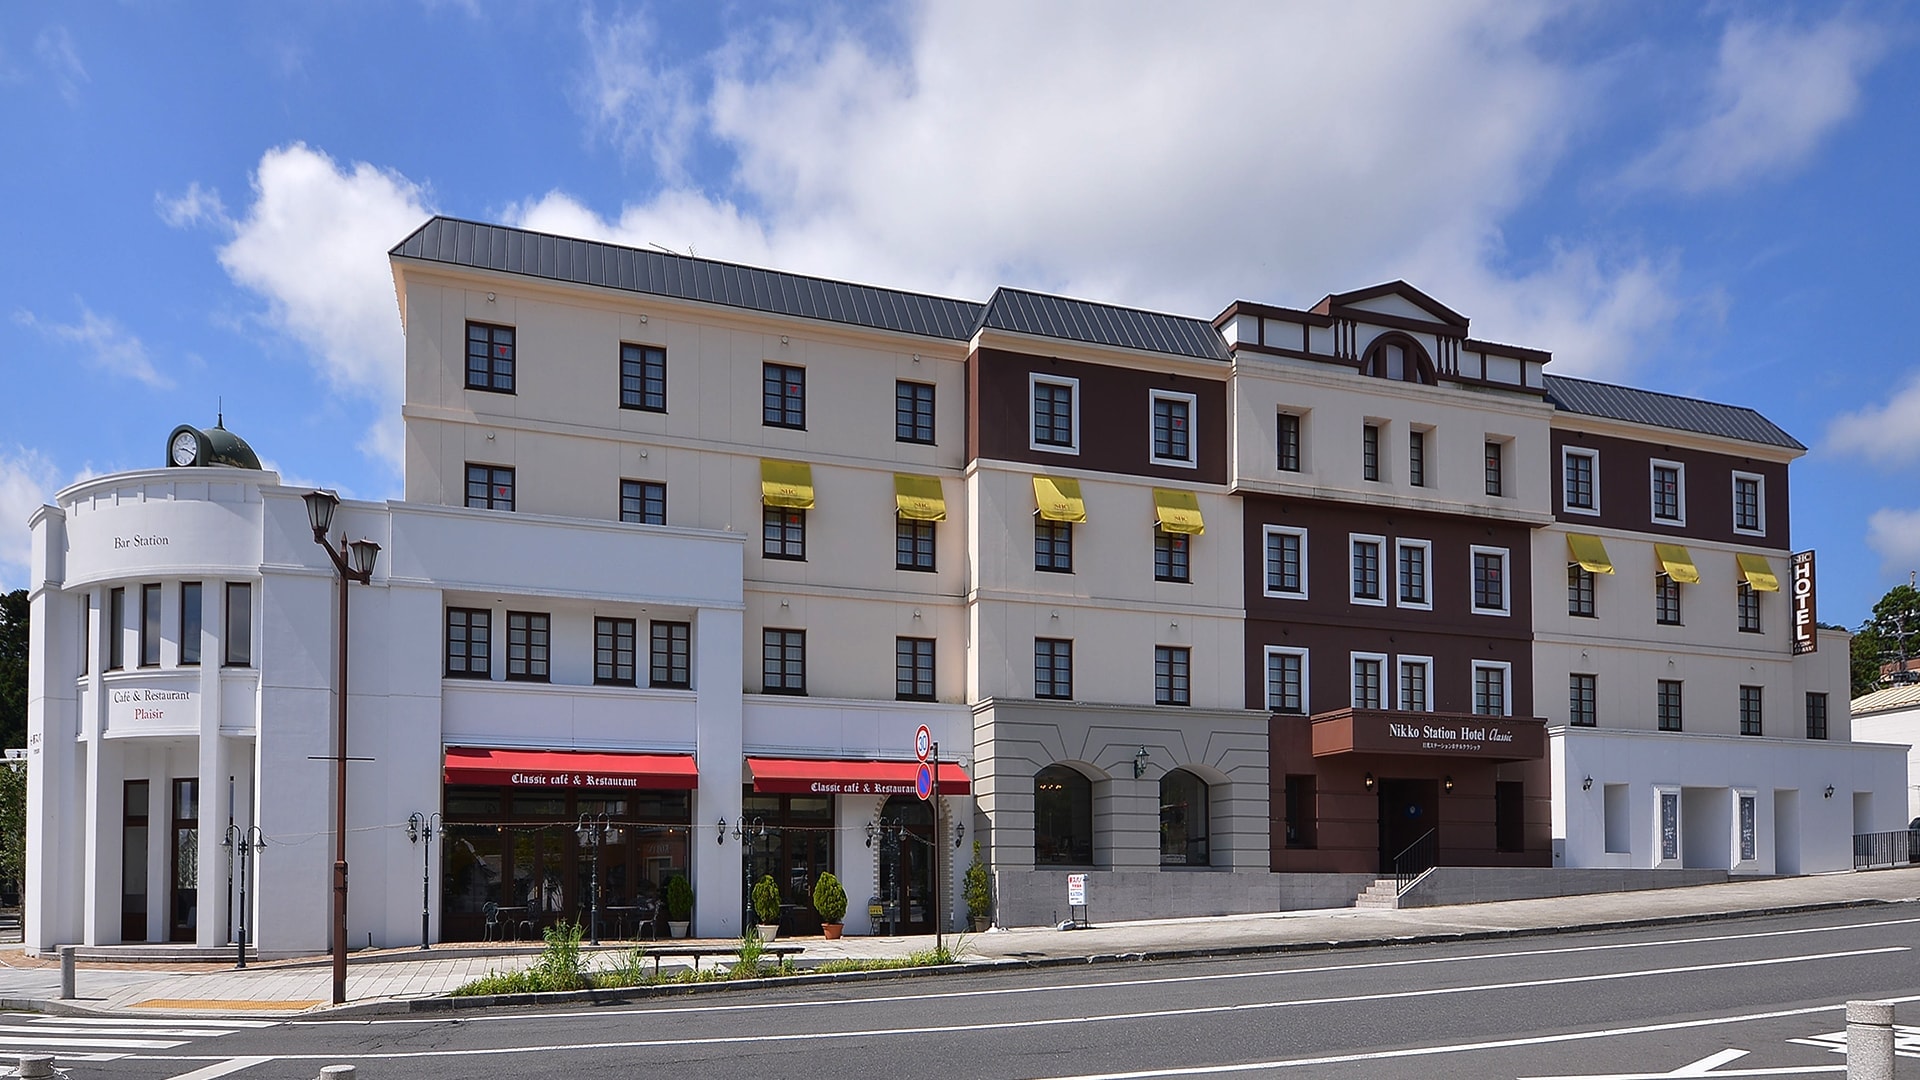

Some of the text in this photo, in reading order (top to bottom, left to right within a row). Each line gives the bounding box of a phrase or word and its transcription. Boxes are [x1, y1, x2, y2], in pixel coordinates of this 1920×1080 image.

[114, 534, 169, 549] Bar Station
[1794, 562, 1811, 641] HOTEL
[114, 690, 190, 704] Café & Restaurant
[134, 708, 164, 720] Plaisir
[1389, 723, 1513, 742] Nikko Station Hotel Classic
[919, 735, 927, 751] 30
[511, 773, 637, 786] Classic café & Restaurant
[810, 782, 917, 793] Classic café & Restauran
